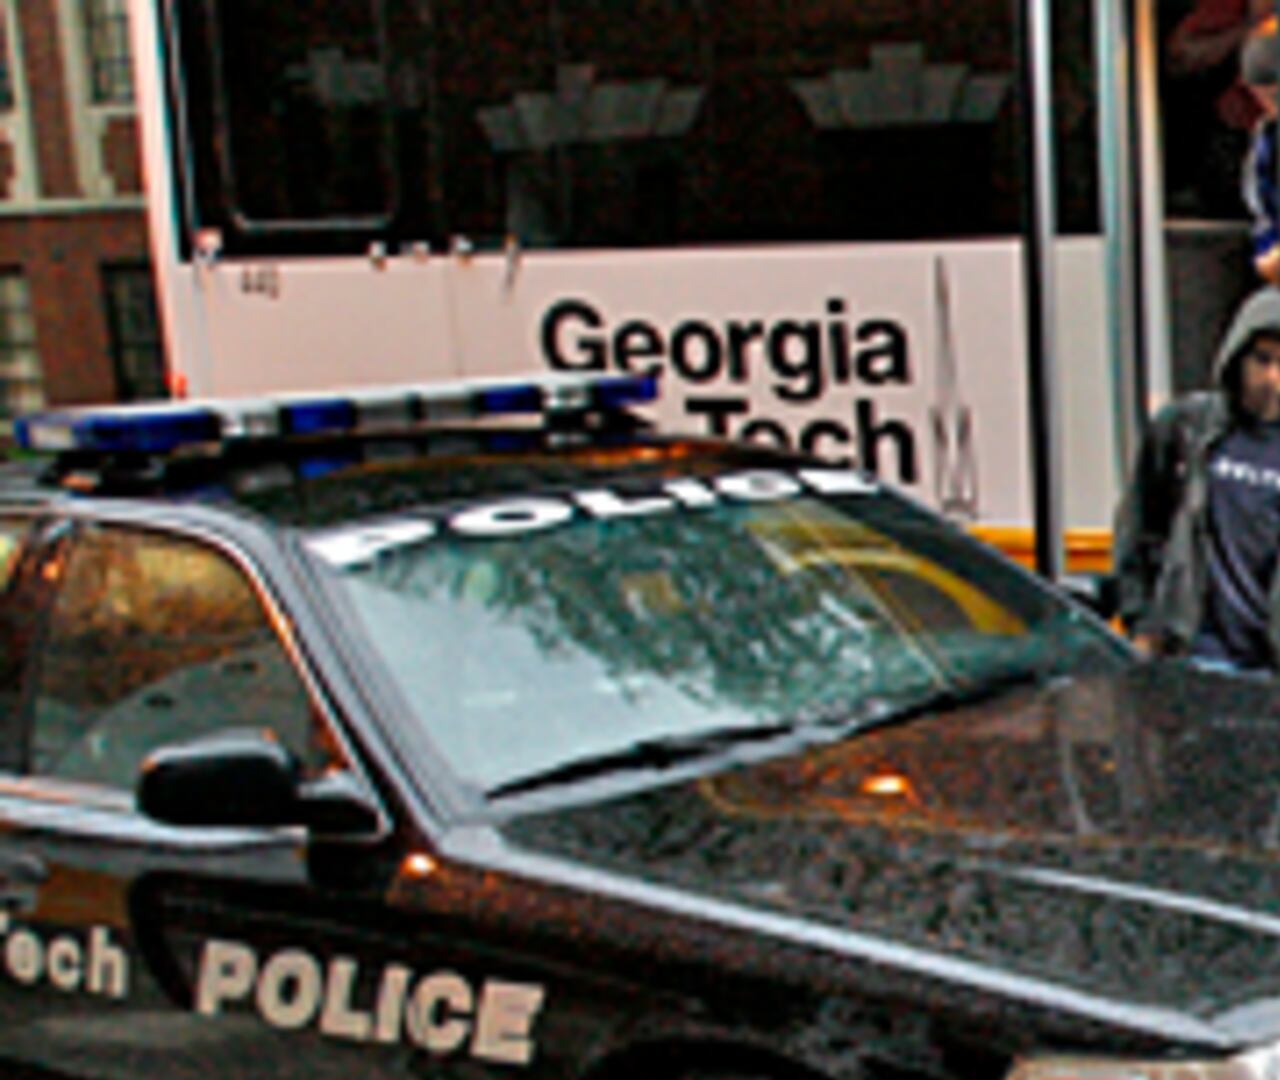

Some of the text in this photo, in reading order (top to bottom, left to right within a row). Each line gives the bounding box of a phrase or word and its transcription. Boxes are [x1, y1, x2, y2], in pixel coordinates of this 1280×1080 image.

[540, 298, 913, 403] Georgia
[301, 468, 884, 566] POLICE
[0, 911, 128, 998] ech
[196, 940, 545, 1065] POLICE
